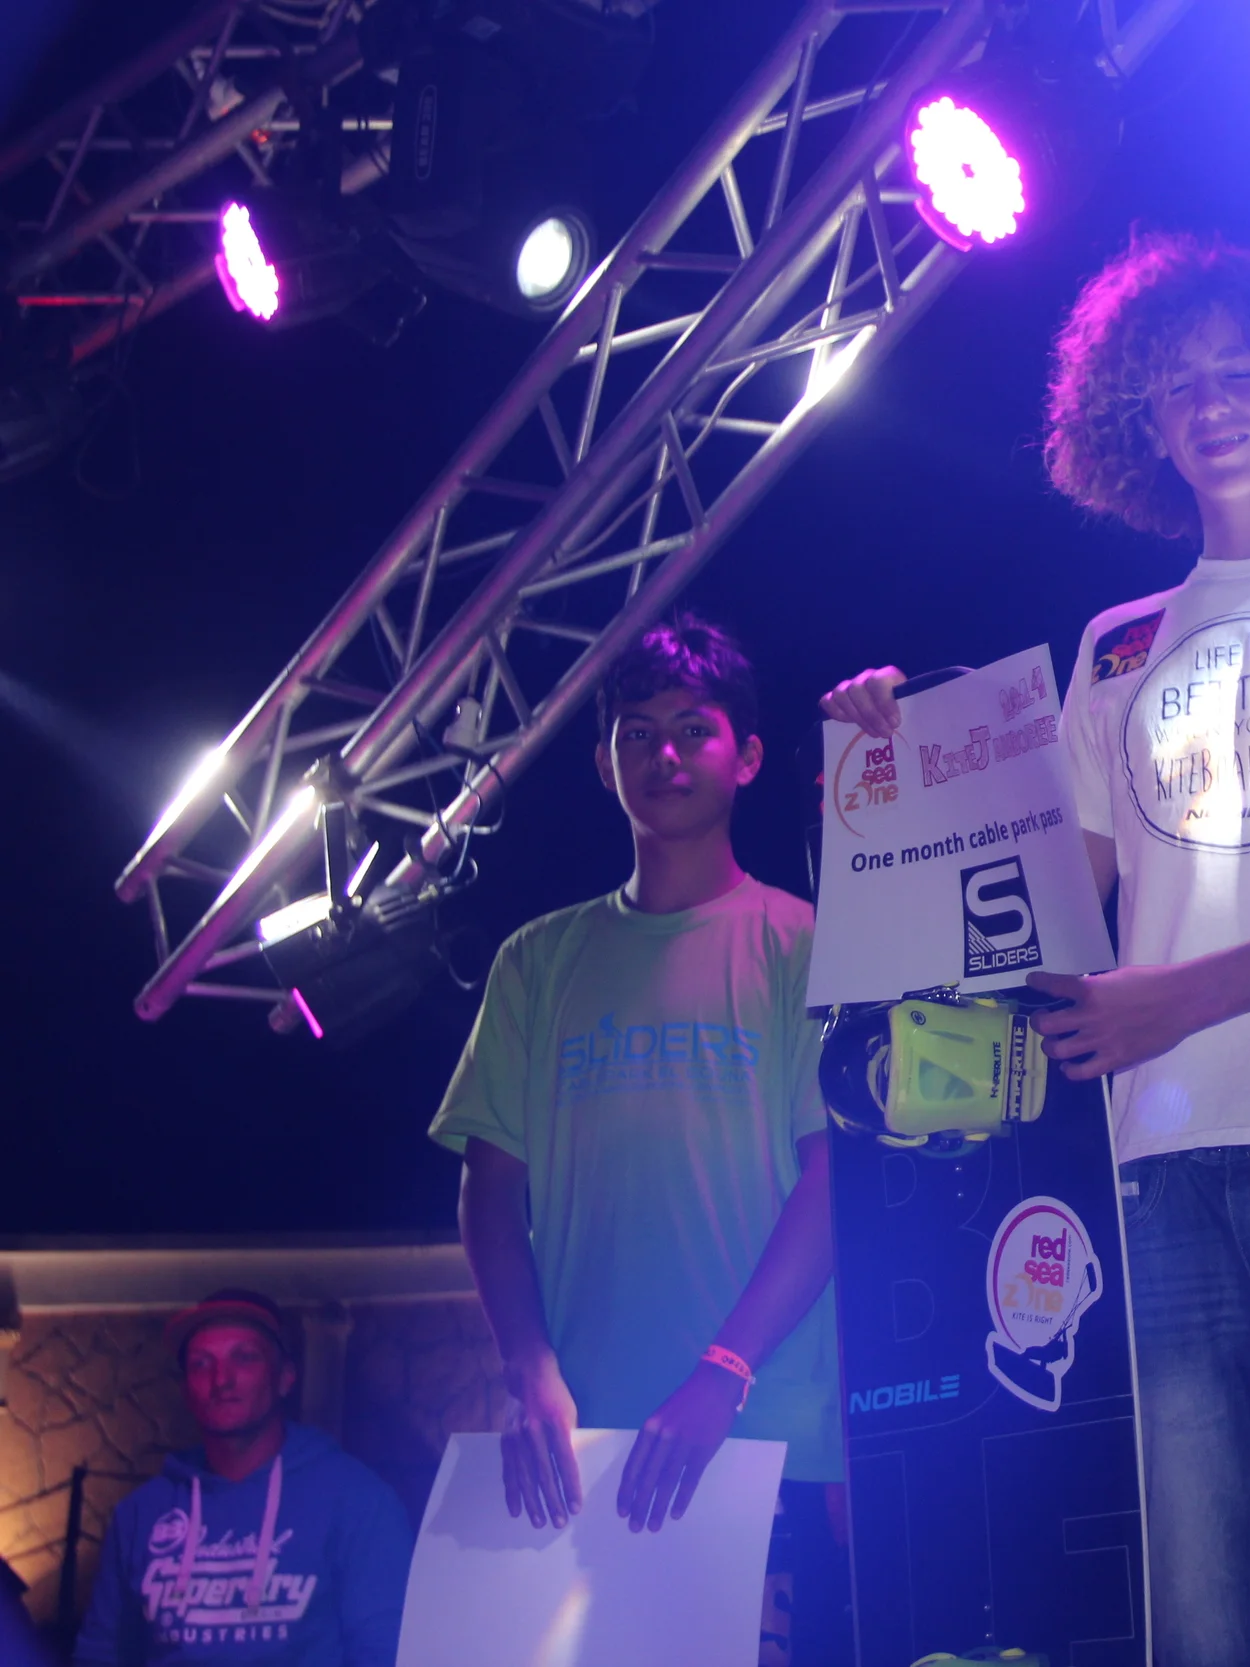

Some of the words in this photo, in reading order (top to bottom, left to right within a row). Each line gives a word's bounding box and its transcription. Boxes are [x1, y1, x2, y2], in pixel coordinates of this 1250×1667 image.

[1196, 643, 1241, 670] LIFE
[865, 737, 895, 768] red
[862, 764, 897, 785] sea
[851, 852, 895, 872] One
[900, 832, 965, 865] month
[968, 820, 1009, 849] cable
[1011, 810, 1041, 843] park
[1040, 806, 1064, 835] pass
[968, 945, 1040, 972] SLIDERS
[560, 1020, 762, 1071] SLIDERS
[988, 1041, 1002, 1099] HYPERLITE
[1031, 1227, 1067, 1262] red
[1024, 1258, 1064, 1288] sea
[1011, 1312, 1026, 1321] KITE
[1026, 1313, 1033, 1322] IS
[1034, 1314, 1053, 1325] RIGHT
[849, 1374, 960, 1416] NOBILE
